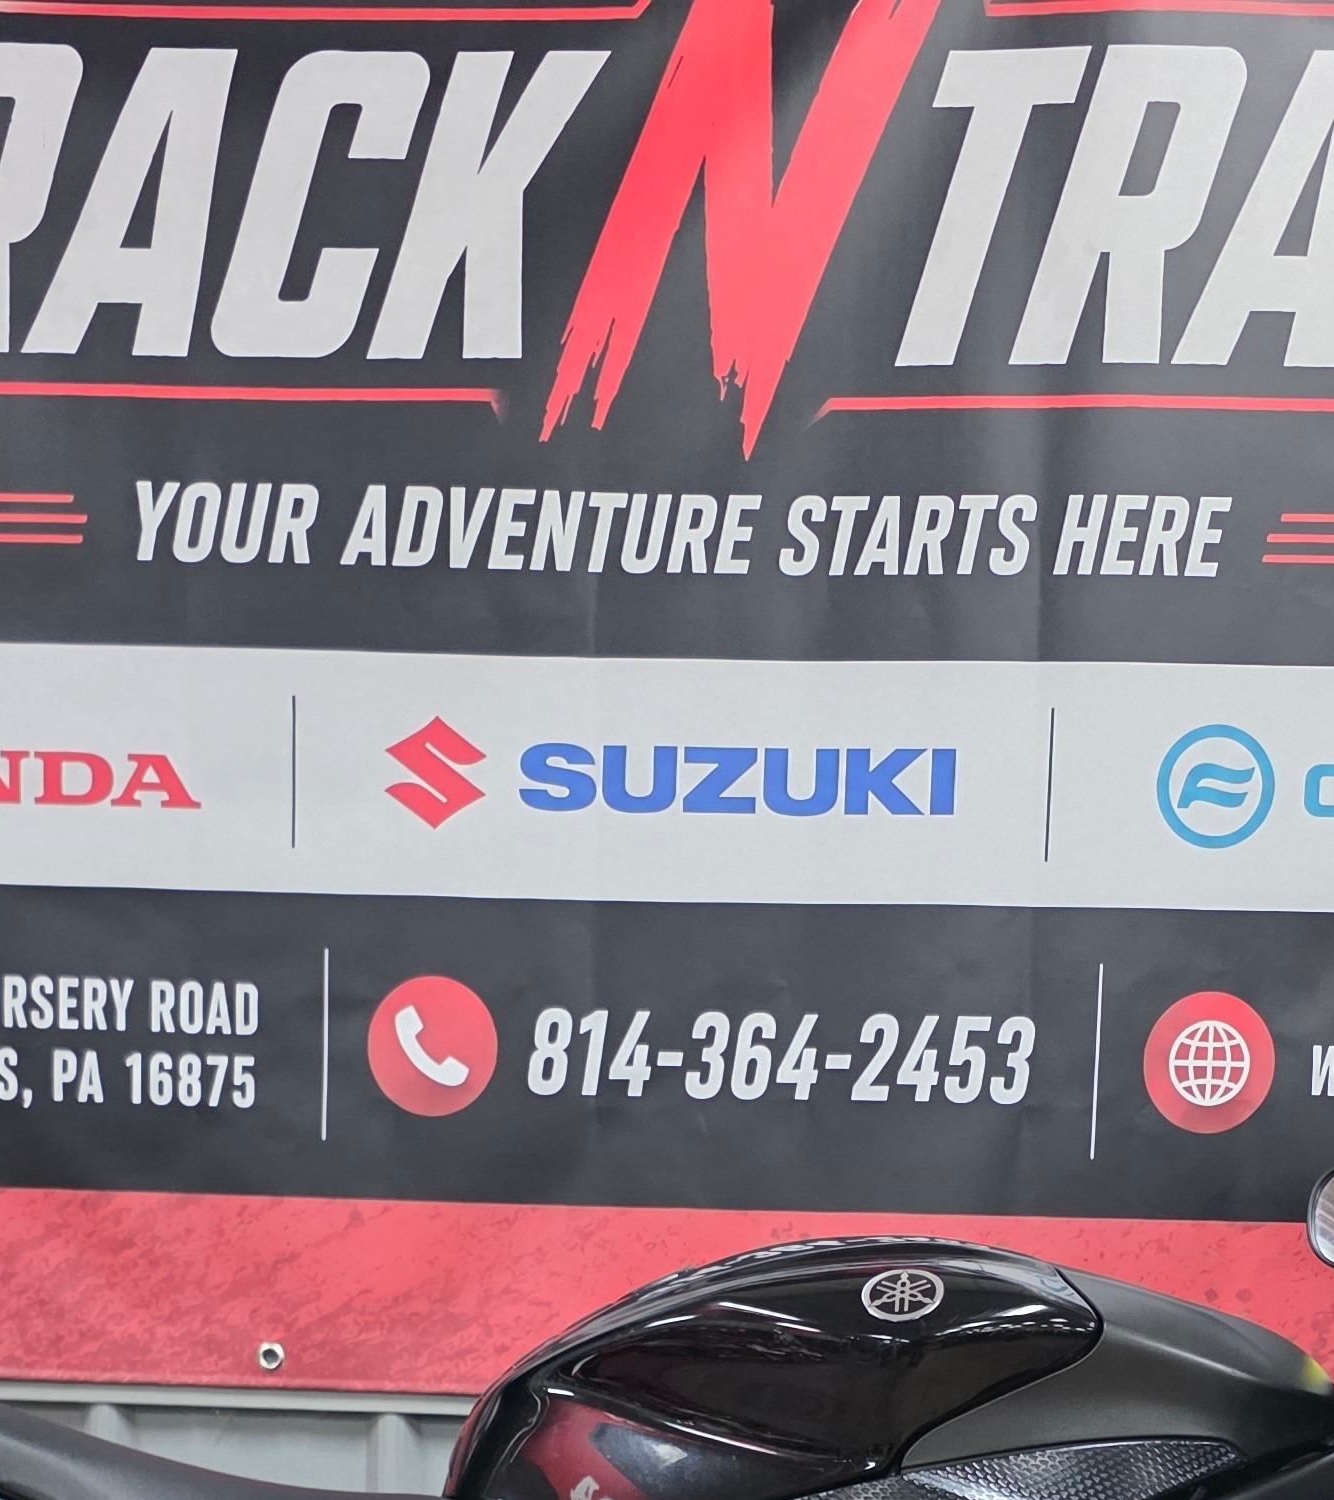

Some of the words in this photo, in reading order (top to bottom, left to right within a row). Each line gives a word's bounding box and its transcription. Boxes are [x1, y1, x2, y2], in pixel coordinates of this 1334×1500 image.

[539, 0, 942, 460] N
[136, 481, 319, 564] YOUR
[340, 485, 762, 574] ADVENTURE
[779, 494, 1037, 576] STARTS
[1053, 494, 1232, 577] HERE
[519, 743, 956, 815] SUZUKI
[151, 980, 258, 1035] ROAD
[53, 1049, 103, 1103] PA
[126, 1052, 255, 1108] 16875
[528, 1008, 1035, 1104] 814-364-2453
